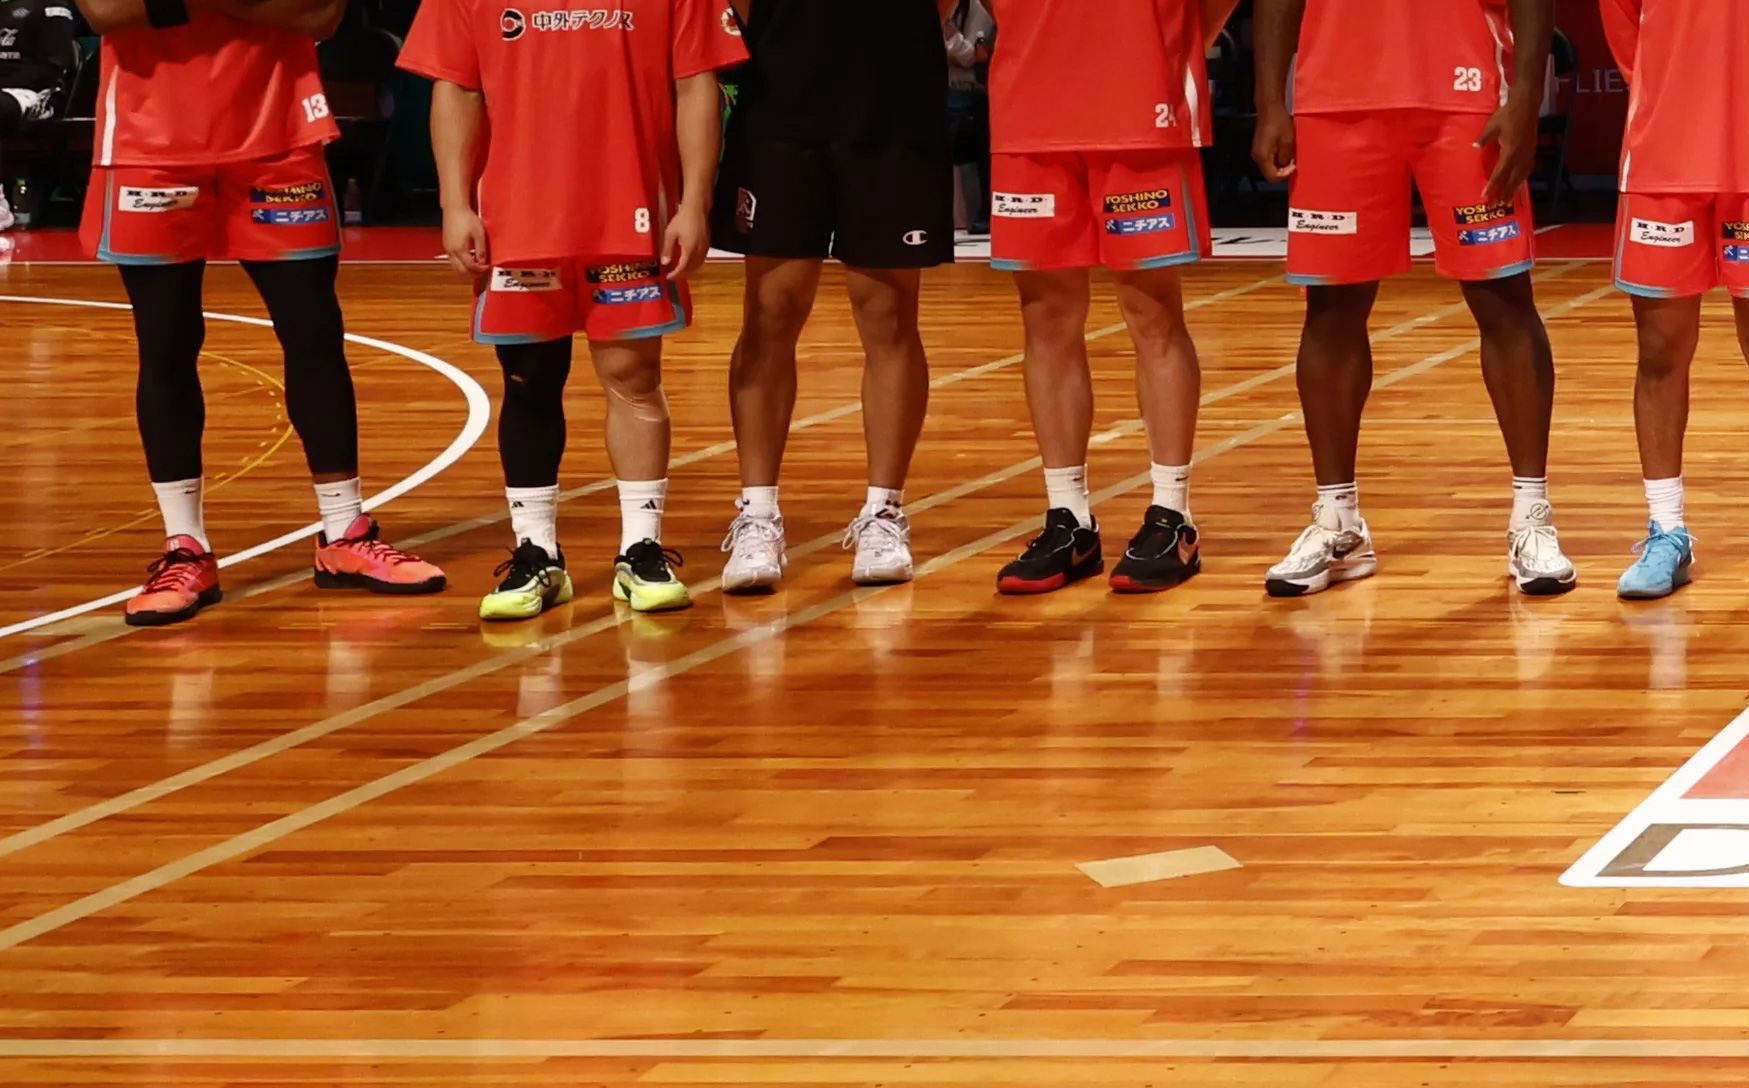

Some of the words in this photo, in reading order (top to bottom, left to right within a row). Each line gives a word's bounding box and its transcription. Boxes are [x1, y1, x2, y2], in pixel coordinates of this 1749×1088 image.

[531, 9, 635, 32] 中外テクノス
[1453, 66, 1482, 92] 23
[301, 92, 330, 123] 13
[1112, 200, 1160, 213] SEKKO
[275, 208, 327, 223] ニチアス
[635, 207, 650, 233] 8
[1123, 216, 1171, 232] ニチアス
[1477, 224, 1517, 242] ニチアス
[598, 270, 650, 283] SEKKO
[609, 285, 662, 302] ニチアス
